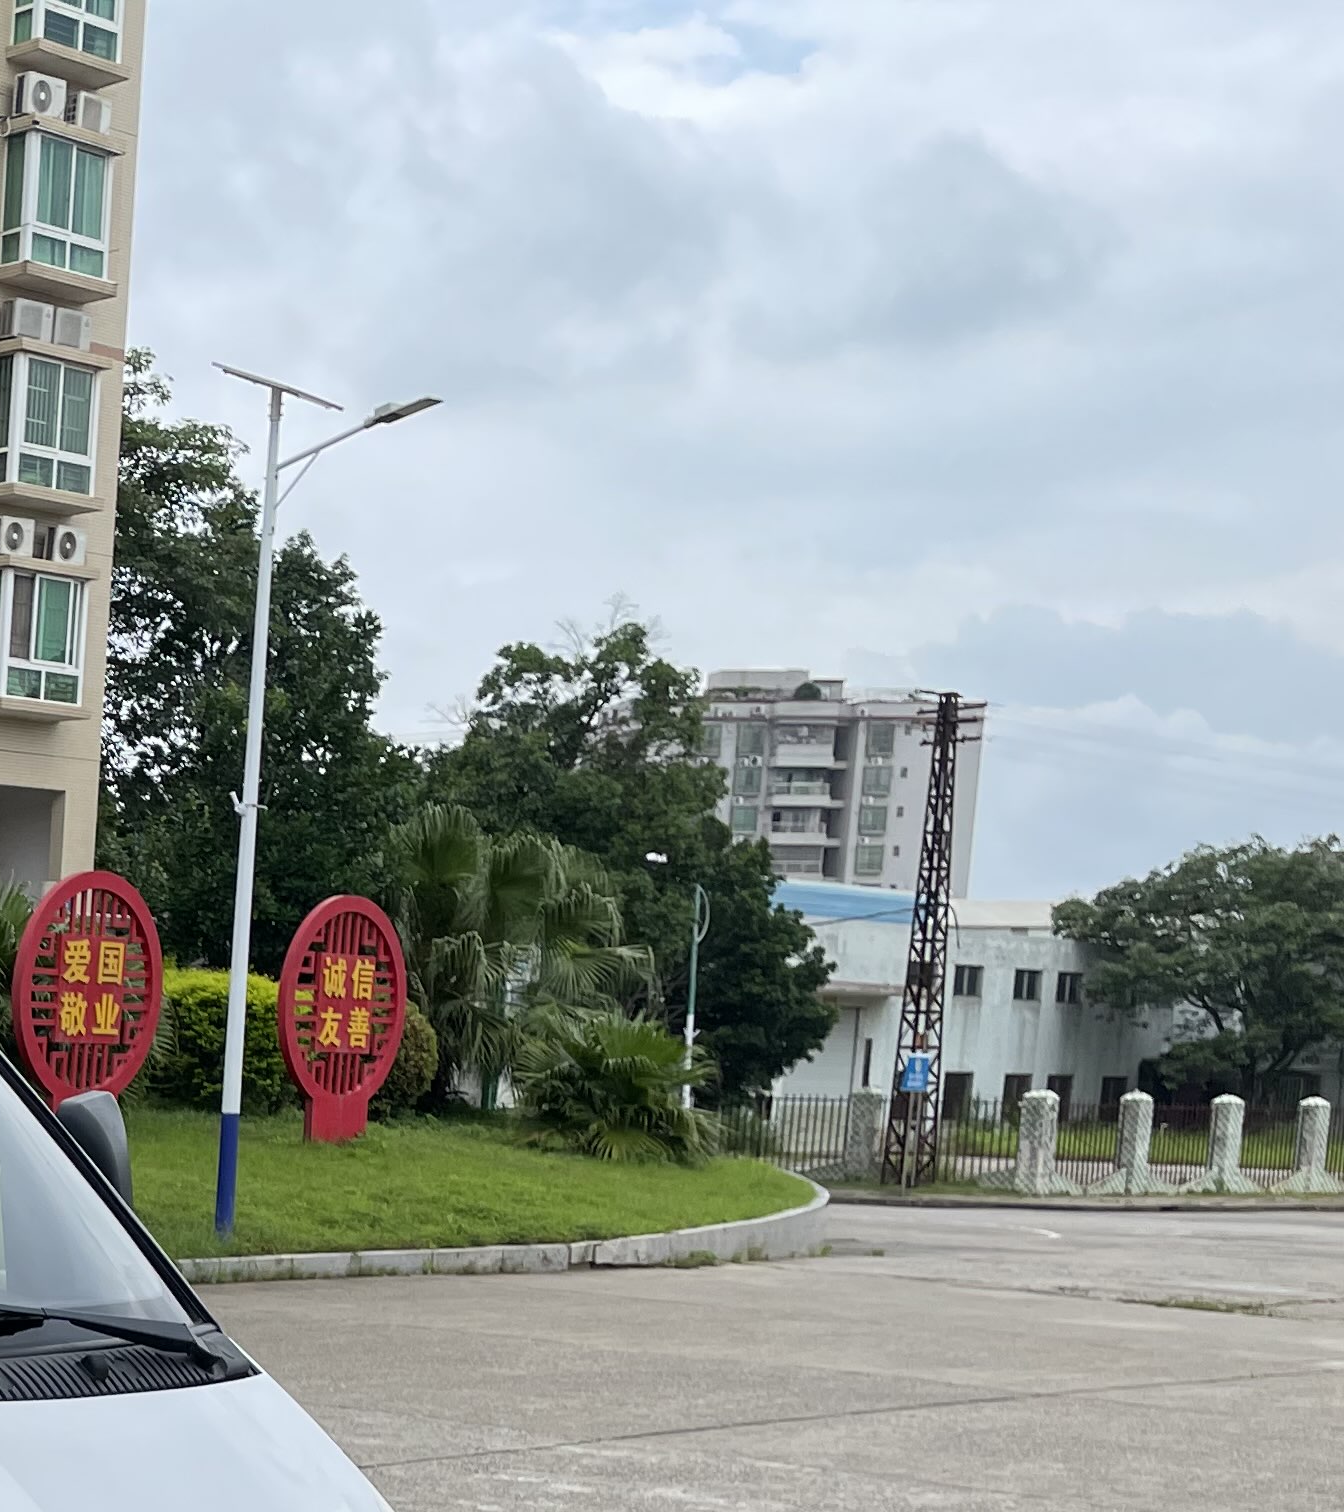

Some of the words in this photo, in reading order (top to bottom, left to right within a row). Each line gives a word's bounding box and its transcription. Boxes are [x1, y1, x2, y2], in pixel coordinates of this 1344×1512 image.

[61, 938, 125, 985] 爱国
[322, 956, 376, 1000] 诚信
[59, 991, 120, 1036] 敬业
[317, 1006, 371, 1048] 友善
